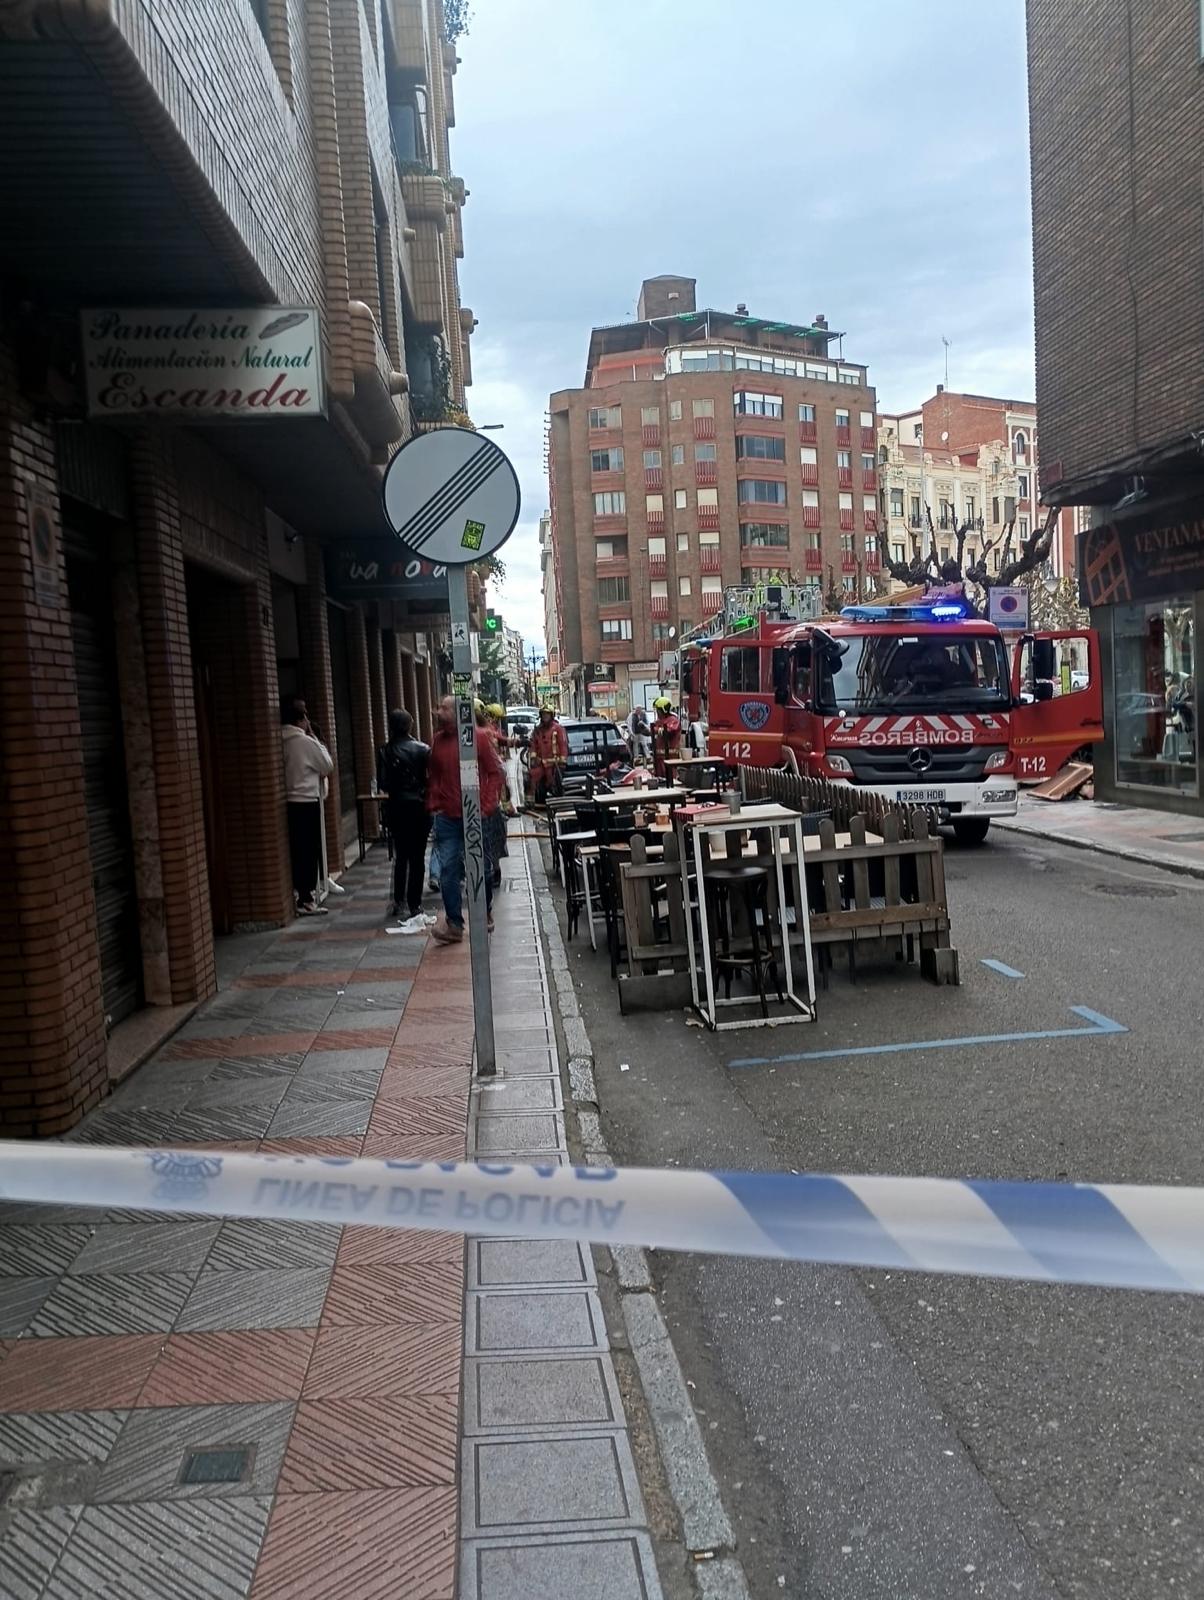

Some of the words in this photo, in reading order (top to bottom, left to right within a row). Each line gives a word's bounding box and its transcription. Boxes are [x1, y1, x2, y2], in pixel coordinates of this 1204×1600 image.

[232, 345, 313, 369] Natural
[98, 372, 312, 408] Escanda
[722, 741, 751, 758] 112
[1020, 756, 1046, 773] T-12
[902, 791, 924, 801] 3298
